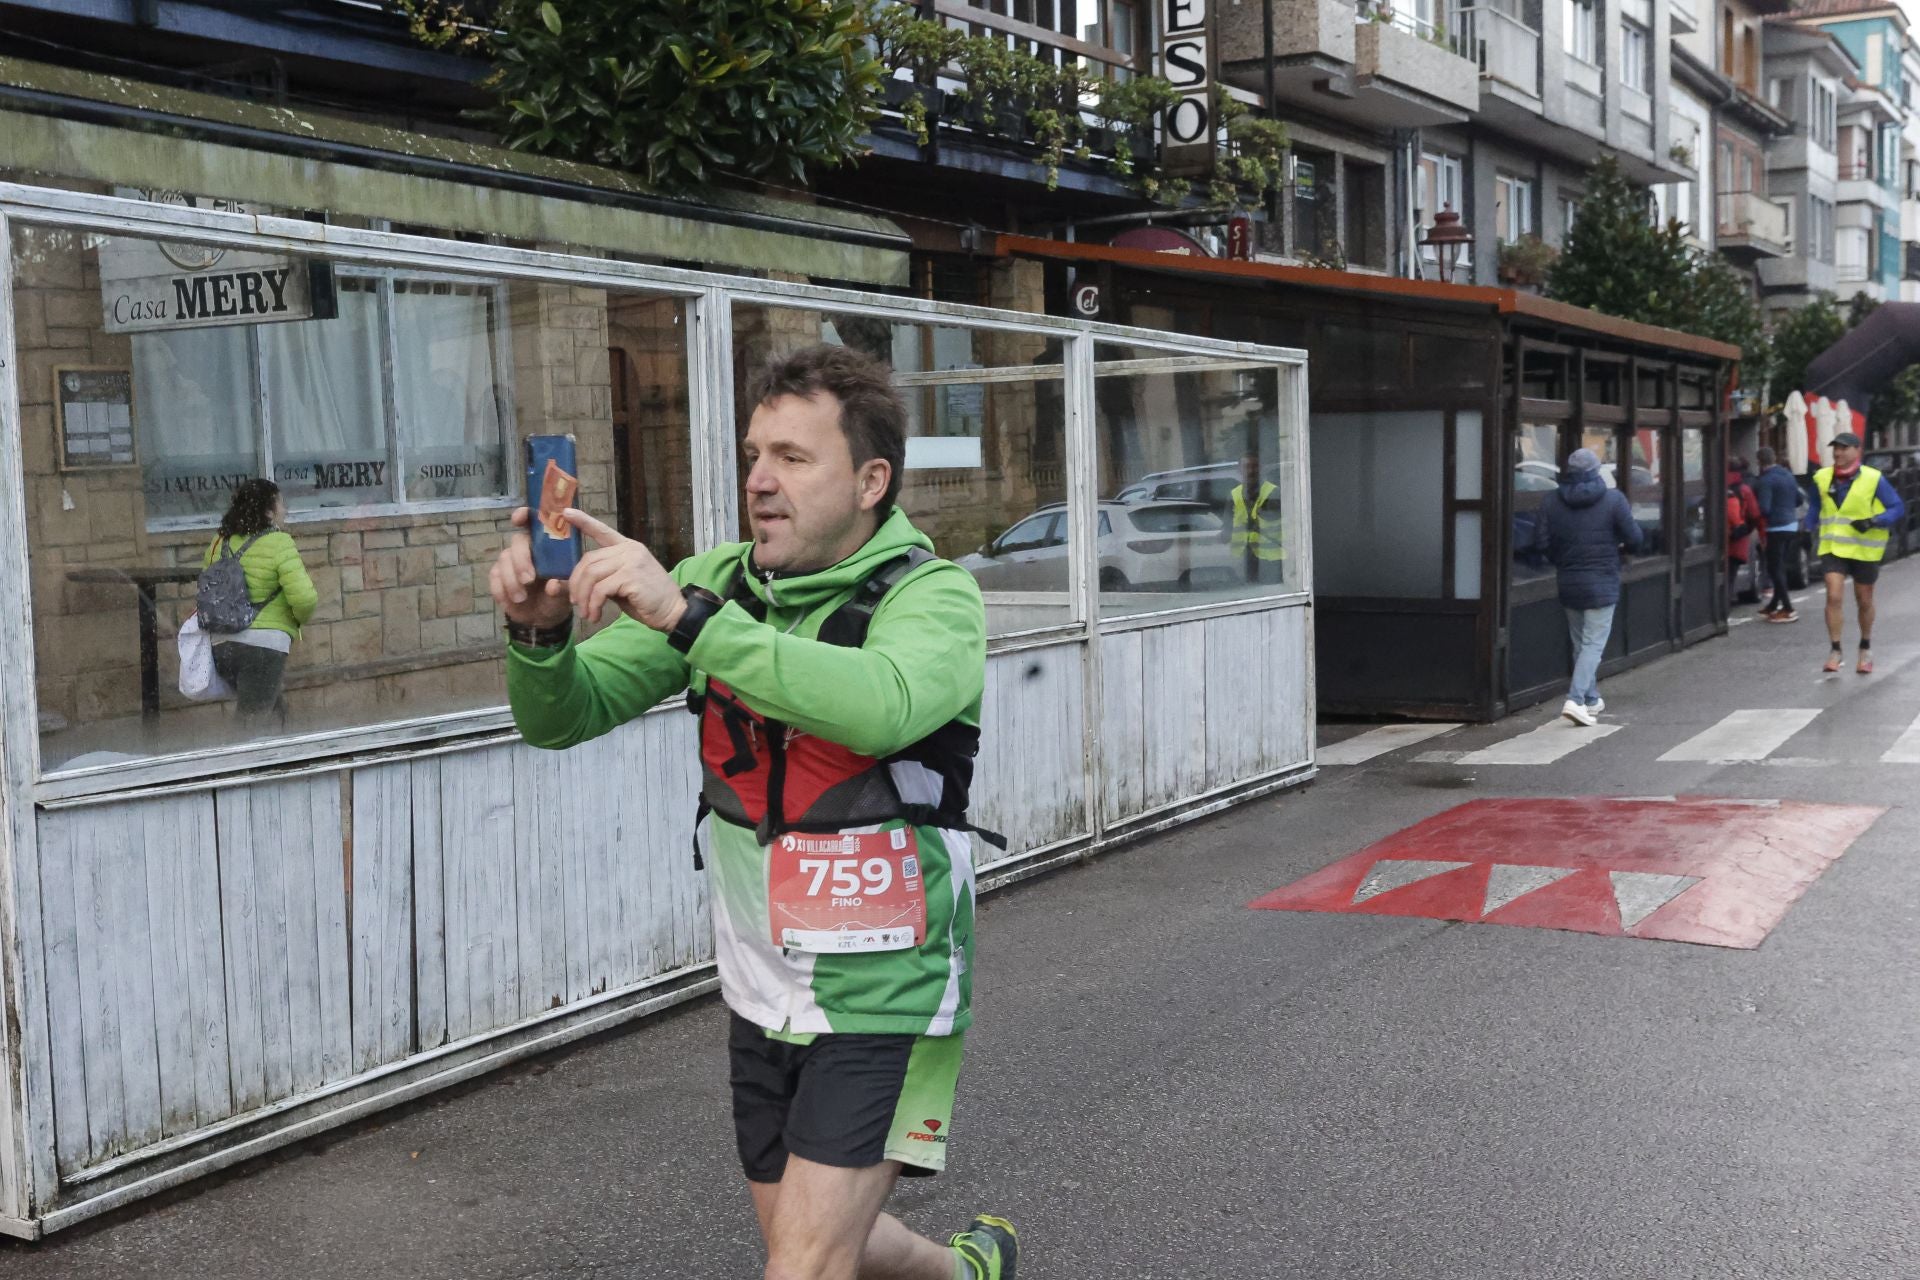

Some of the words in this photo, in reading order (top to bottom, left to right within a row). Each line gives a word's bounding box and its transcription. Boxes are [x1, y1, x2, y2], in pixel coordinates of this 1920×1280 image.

[114, 294, 168, 325] Casa
[171, 268, 290, 320] MERY
[273, 462, 309, 482] Casa
[313, 461, 386, 489] MERY
[420, 463, 486, 480] SIDRERIA
[799, 857, 892, 897] 759
[831, 897, 863, 908] FINO
